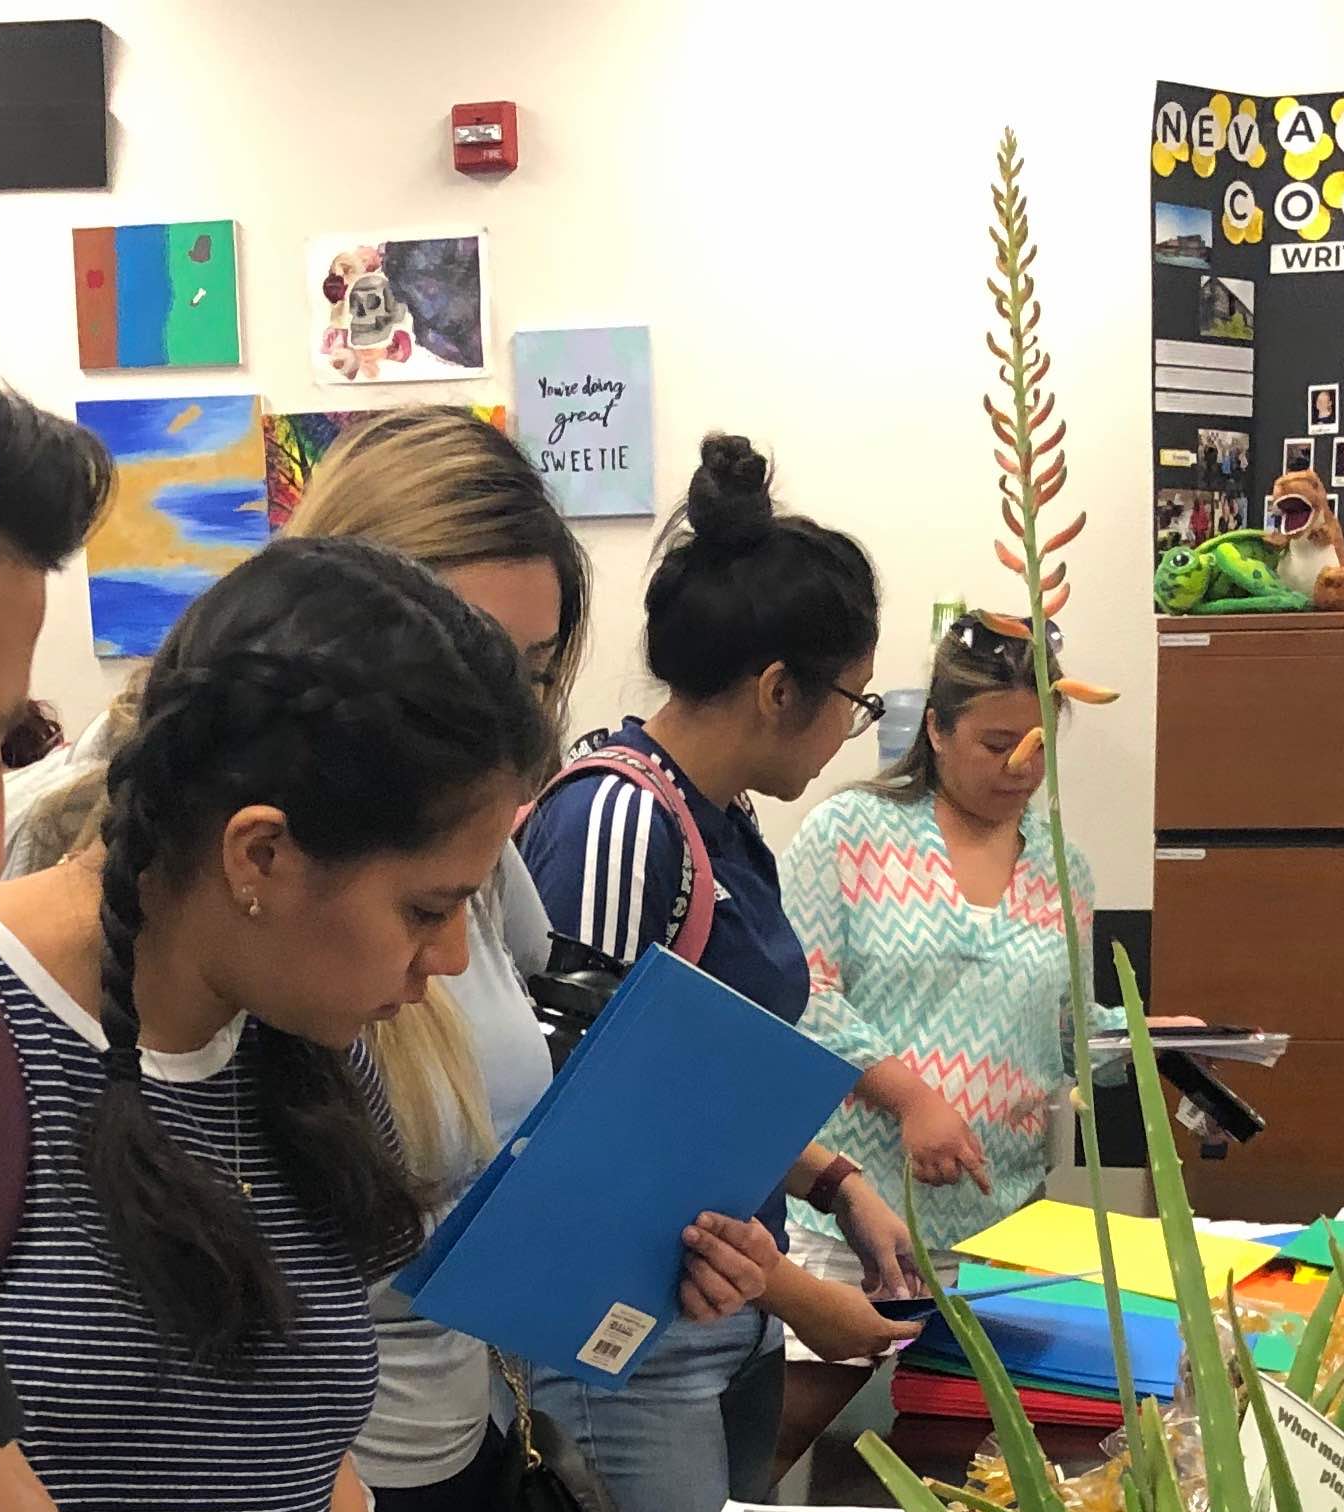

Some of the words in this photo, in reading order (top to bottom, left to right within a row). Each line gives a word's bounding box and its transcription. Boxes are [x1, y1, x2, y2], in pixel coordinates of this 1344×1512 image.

[582, 374, 626, 399] doing
[548, 398, 619, 445] great
[540, 446, 630, 472] SWEETIE
[1278, 1406, 1319, 1449] What
